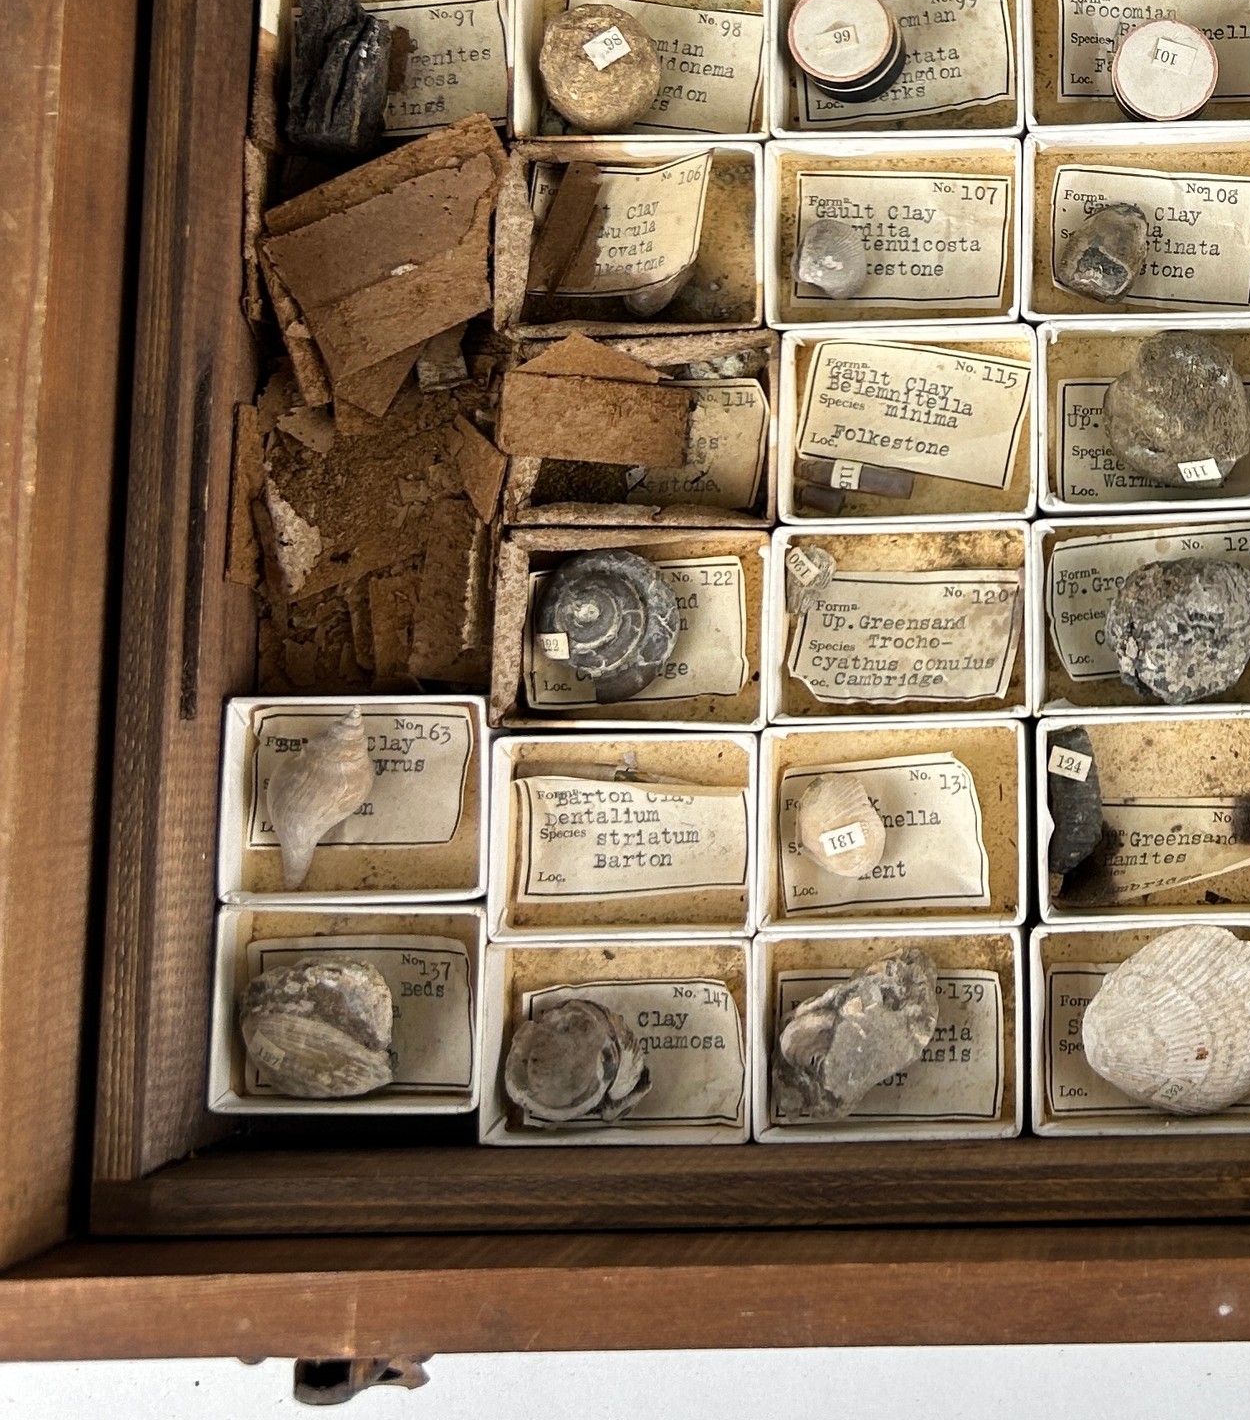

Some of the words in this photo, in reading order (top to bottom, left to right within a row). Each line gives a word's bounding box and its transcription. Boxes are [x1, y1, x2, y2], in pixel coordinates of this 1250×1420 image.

[455, 10, 475, 27] 97
[1073, 2, 1178, 20] Neocomian
[721, 21, 741, 38] 98
[833, 30, 851, 45] 99
[603, 33, 623, 51] 98
[1070, 74, 1093, 85] Loc.
[816, 100, 844, 110] Loc.
[677, 165, 702, 185] 106
[932, 182, 956, 194] No.
[961, 185, 998, 206] 107
[1203, 187, 1239, 205] 108
[627, 201, 660, 220] Clay
[815, 203, 875, 220] Gault
[888, 204, 937, 225] Clay
[1154, 206, 1202, 226] Clay
[608, 238, 654, 258] ovata
[862, 238, 982, 254] tenuicosta
[828, 365, 891, 386] Gault
[904, 376, 953, 398] Clay
[954, 361, 977, 375] No.
[982, 365, 1019, 389] 115
[722, 391, 757, 408] 114
[819, 393, 866, 411] Species
[826, 378, 974, 416] Belemnitella
[884, 404, 959, 429] minima
[810, 433, 839, 448] Loc.
[831, 423, 950, 457] Folkestone
[1071, 485, 1099, 497] Loc.
[1181, 539, 1205, 551] No.
[700, 570, 734, 587] 122
[942, 586, 966, 599] No.
[971, 589, 1009, 605] 120
[1061, 610, 1106, 625] Species
[809, 639, 856, 653] Species
[868, 633, 953, 650] Trocho-
[811, 654, 900, 672] cyathus
[913, 654, 998, 672] conulus
[1067, 653, 1095, 665] Loc.
[834, 671, 944, 688] Cambridge
[413, 722, 452, 745] 163
[1056, 754, 1083, 774] 124
[909, 769, 932, 781] No.
[544, 807, 661, 828] Dentalium
[540, 828, 587, 843] Species
[596, 828, 700, 847] striatum
[592, 851, 673, 870] Barton
[537, 871, 566, 884] Loc.
[793, 884, 818, 897] Loc.
[419, 960, 452, 981] 137
[401, 981, 445, 998] Beds
[673, 986, 697, 998] No.
[703, 988, 729, 1011] 147
[947, 983, 985, 1003] 139
[638, 1011, 690, 1030] Clay
[1059, 1084, 1088, 1097] Loc.
